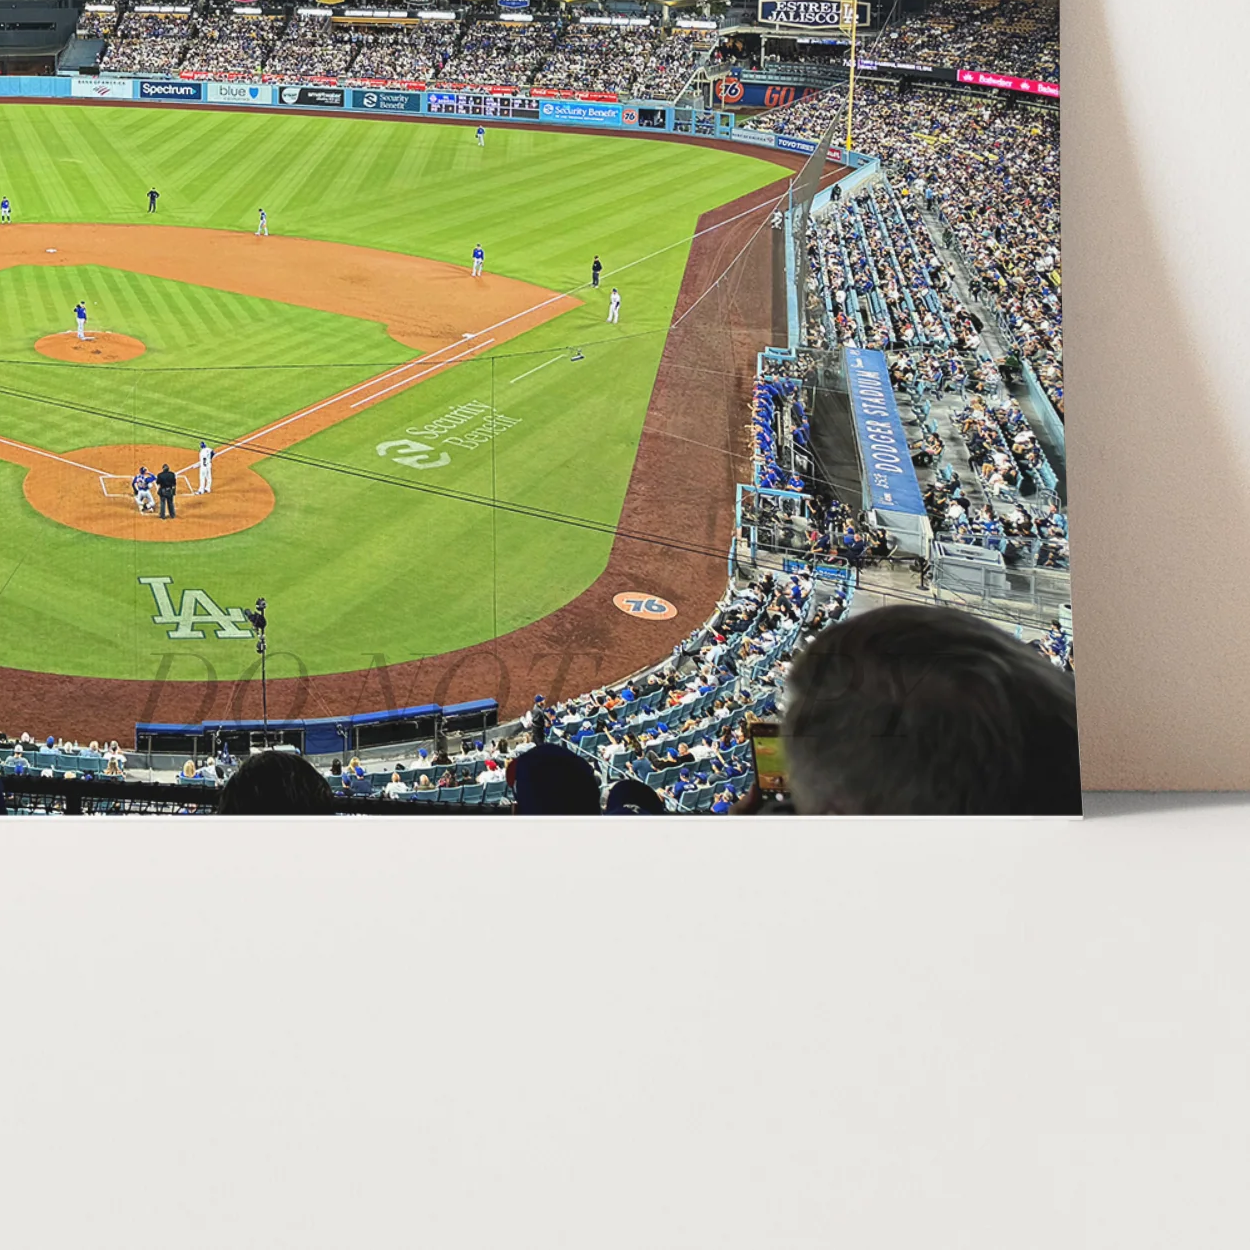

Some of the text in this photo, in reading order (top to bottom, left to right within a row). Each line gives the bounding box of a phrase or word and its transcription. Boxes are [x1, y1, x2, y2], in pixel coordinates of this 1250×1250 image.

[767, 11, 839, 23] JALISCO
[143, 83, 193, 97] Spectrum
[220, 85, 246, 97] blue
[719, 82, 741, 96] 76
[379, 93, 410, 103] Security
[764, 86, 795, 108] GO
[379, 101, 405, 110] Benefit
[555, 105, 587, 117] Security
[588, 107, 617, 118] Benefit
[624, 111, 636, 121] 76
[778, 139, 797, 148] TOYO
[857, 371, 889, 417] STADIUM
[406, 400, 492, 439] Security
[442, 409, 522, 450] Benefit
[865, 420, 903, 473] DODGER
[137, 576, 254, 639] LA
[622, 599, 668, 613] 76
